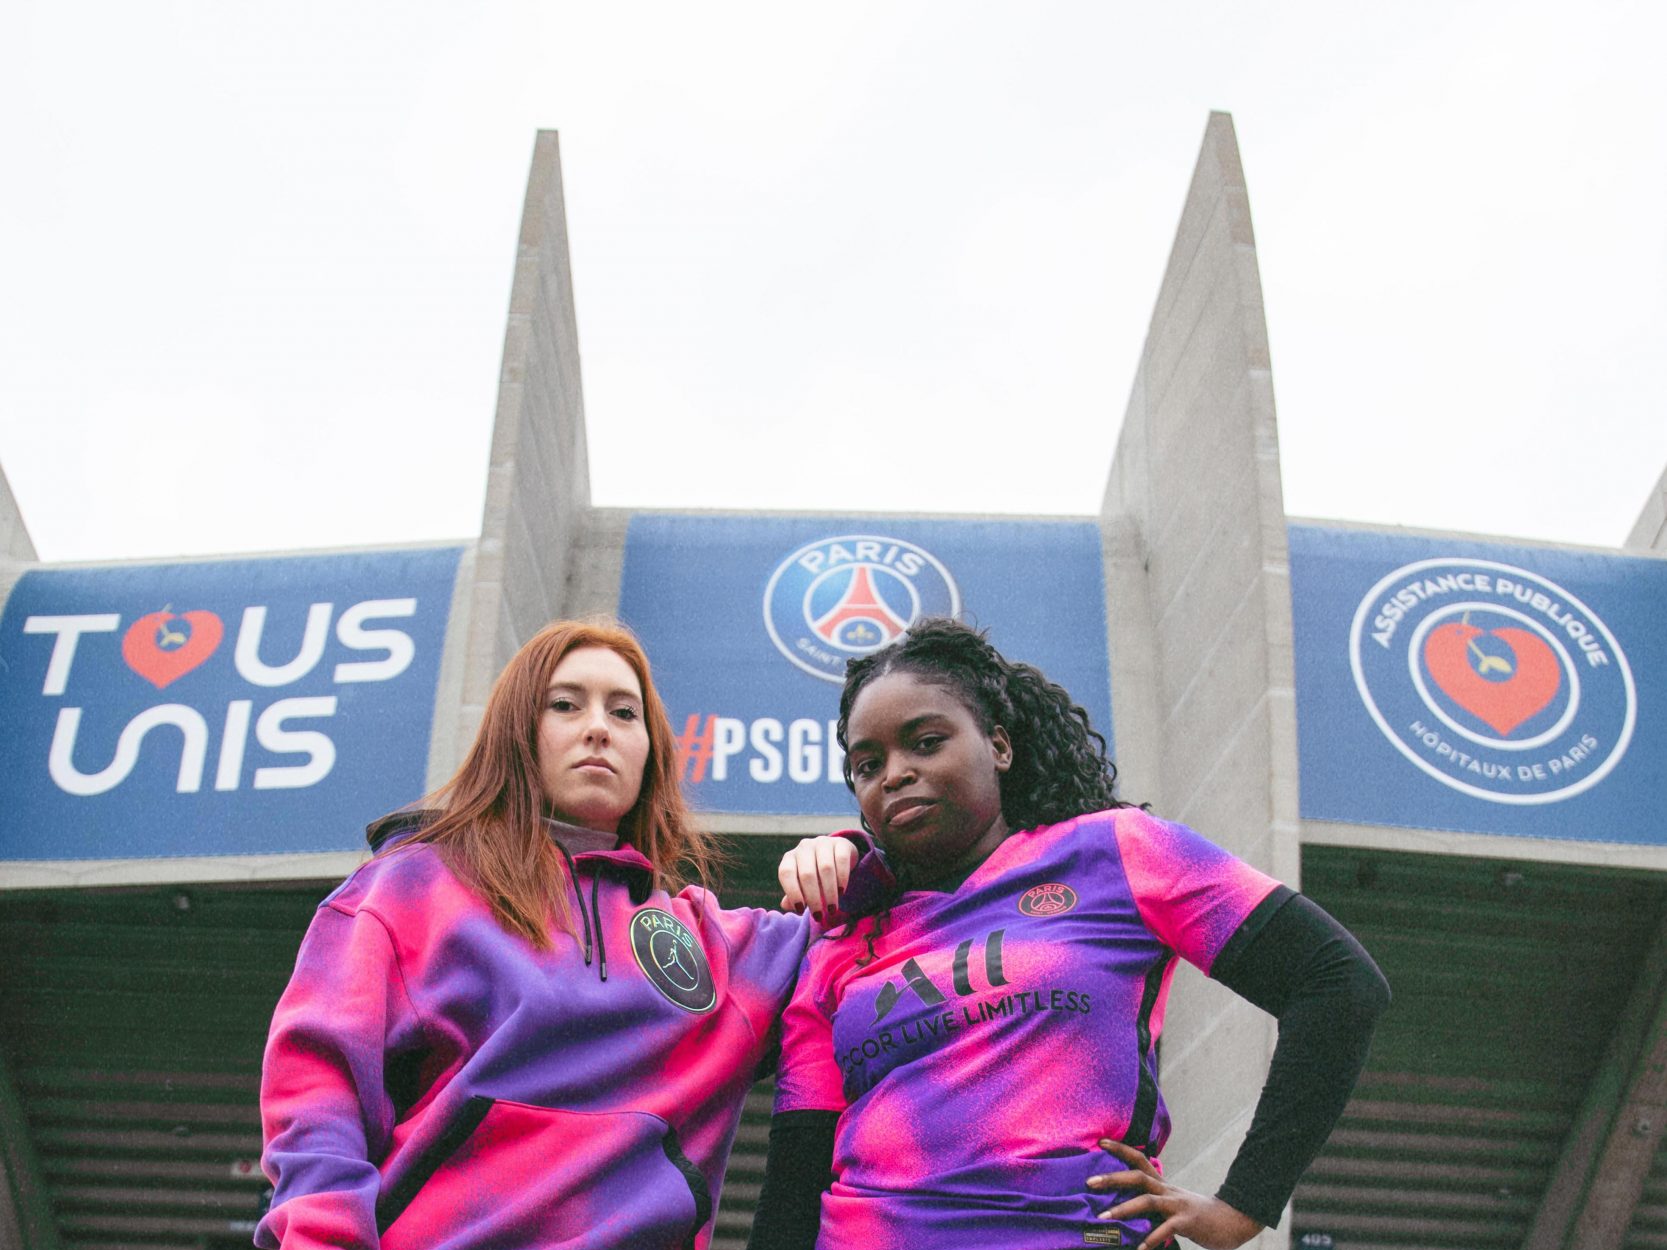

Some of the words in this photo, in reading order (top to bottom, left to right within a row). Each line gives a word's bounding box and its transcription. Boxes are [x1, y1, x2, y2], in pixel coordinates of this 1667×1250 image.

[799, 541, 927, 576] PARIS
[1371, 573, 1493, 649] ASSISTANCE
[1495, 578, 1610, 668] PUBLIQUE
[48, 696, 338, 796] UNIS
[1517, 766, 1547, 781] DE
[1548, 733, 1599, 775] PARIS
[1028, 885, 1064, 898] PARIS
[640, 914, 693, 948] PARIS
[842, 1032, 898, 1075] CCOR
[902, 1011, 960, 1044] LIVE
[963, 988, 1092, 1026] LIMITLESS
